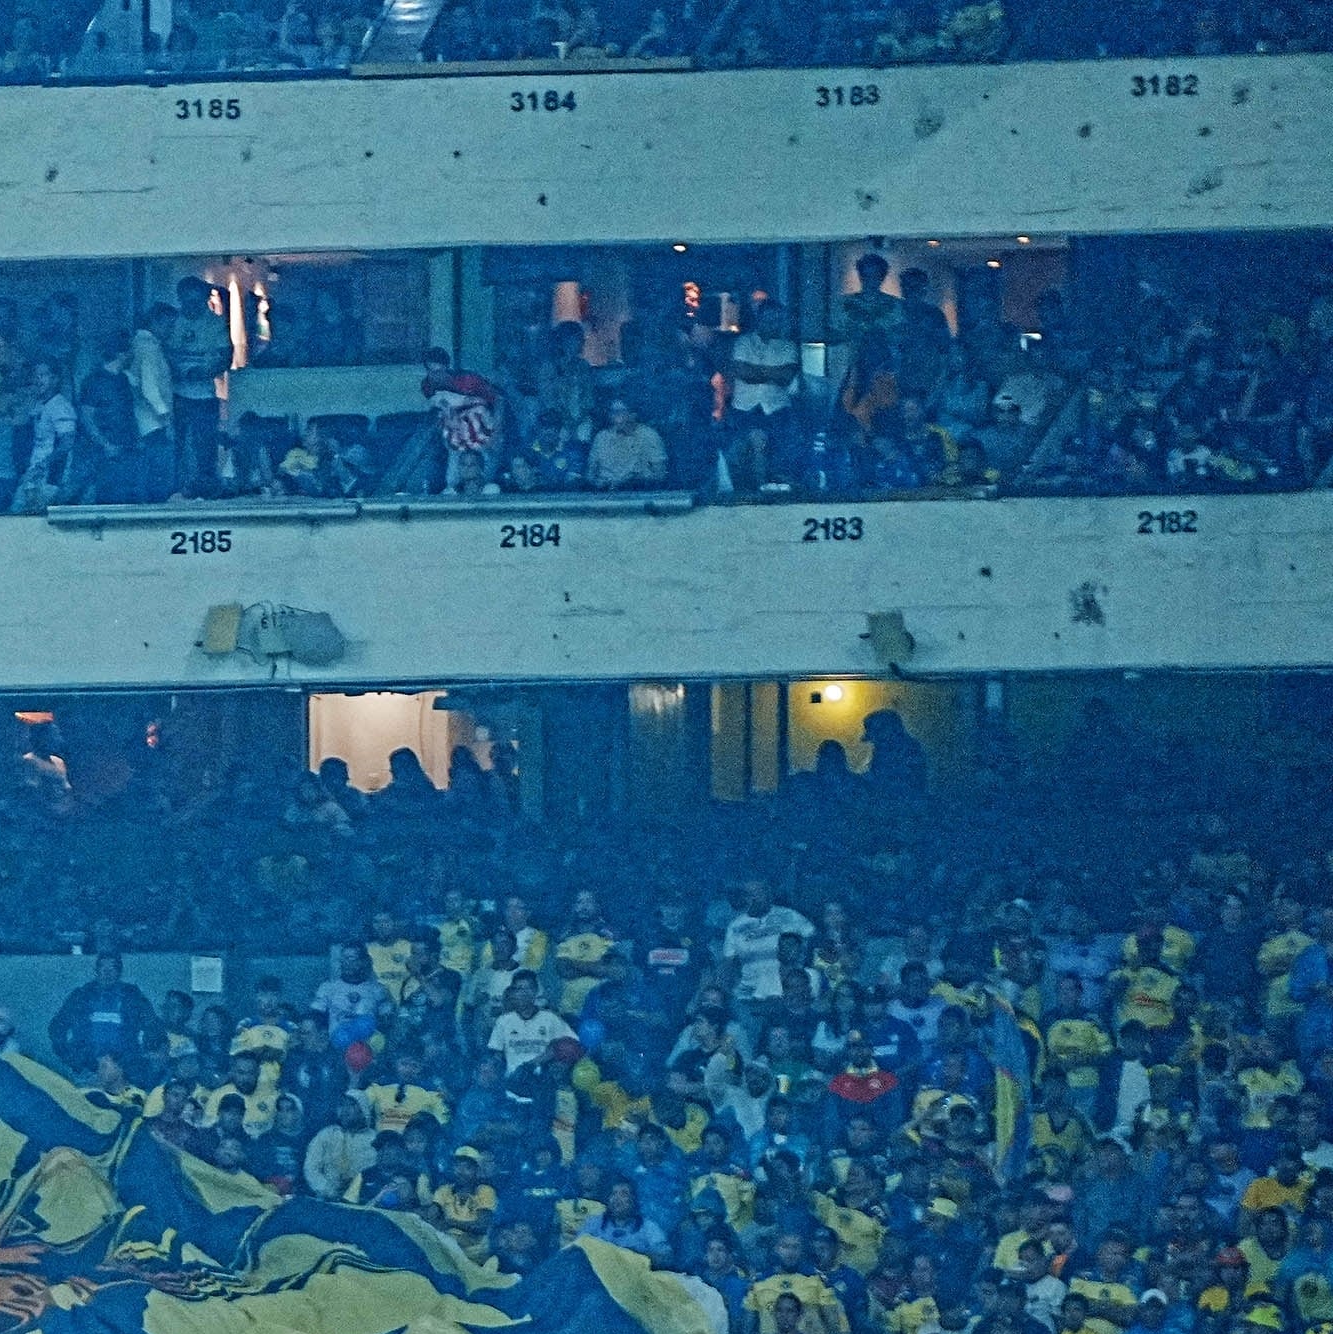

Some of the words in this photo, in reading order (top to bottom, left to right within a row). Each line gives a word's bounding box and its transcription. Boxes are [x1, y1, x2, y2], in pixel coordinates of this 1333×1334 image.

[511, 91, 576, 112] 3184
[817, 85, 880, 107] 3183
[176, 99, 241, 120] 3185
[803, 517, 863, 542] 2183
[1138, 511, 1197, 534] 2182
[171, 530, 231, 554] 2185
[501, 524, 560, 548] 2184
